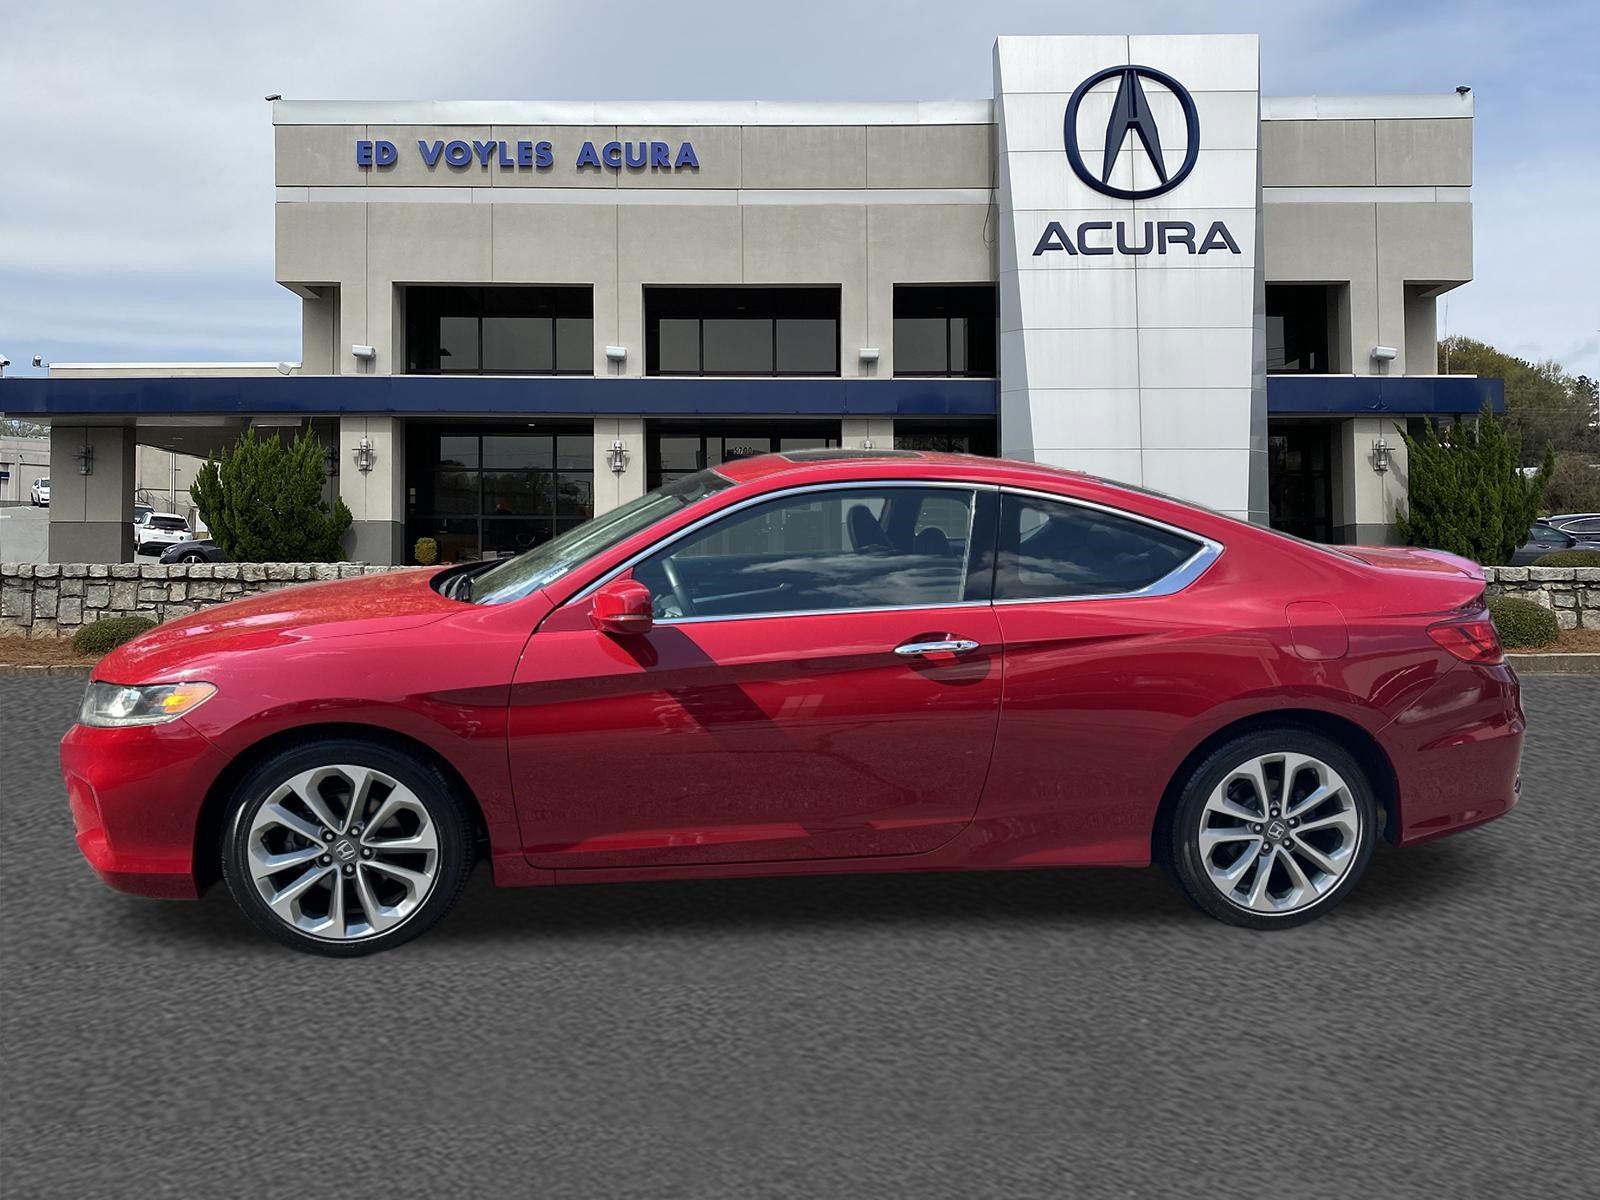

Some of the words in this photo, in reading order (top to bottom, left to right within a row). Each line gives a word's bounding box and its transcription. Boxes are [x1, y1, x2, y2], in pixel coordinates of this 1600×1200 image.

[356, 140, 398, 167] ED
[419, 140, 554, 168] VOYLES
[576, 141, 700, 169] ACURA
[1032, 221, 1241, 256] ACURA
